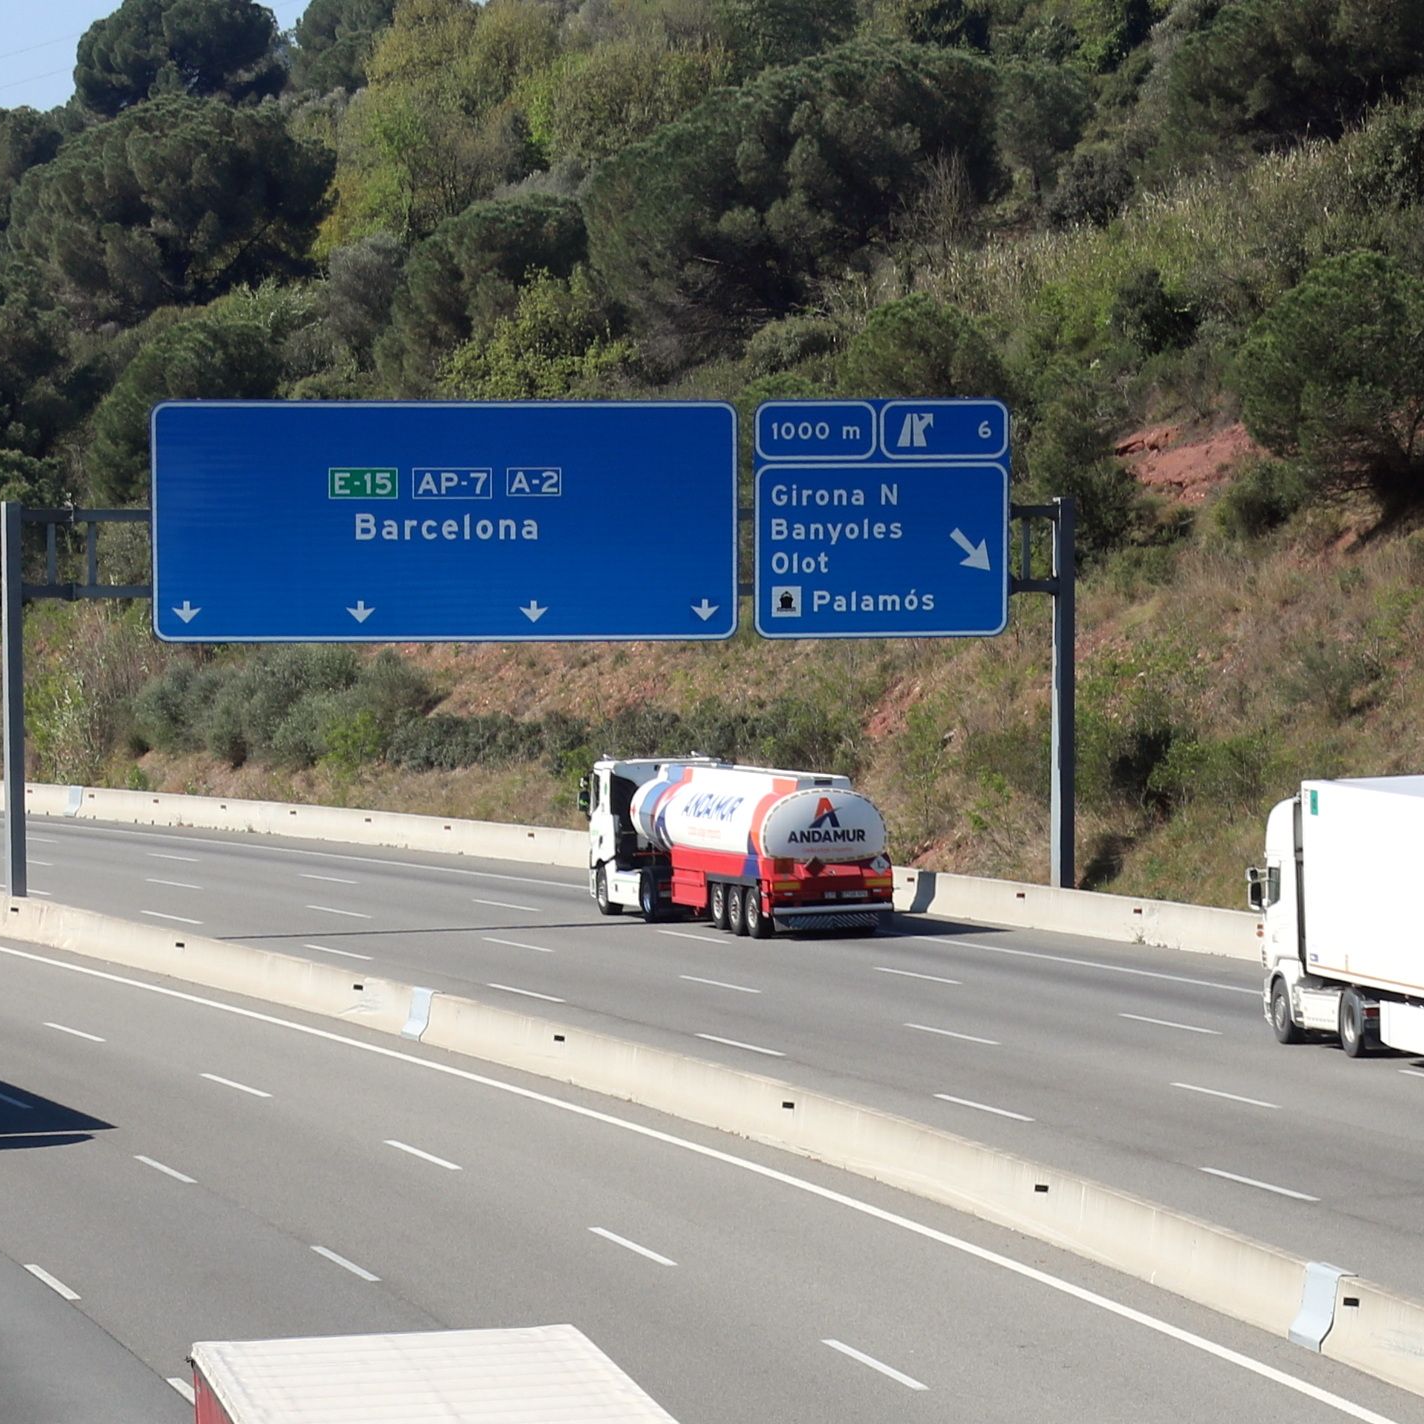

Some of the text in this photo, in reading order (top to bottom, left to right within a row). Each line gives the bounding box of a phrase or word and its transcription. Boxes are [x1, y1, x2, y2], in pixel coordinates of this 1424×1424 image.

[772, 422, 861, 440] 1000 m
[978, 420, 992, 439] 6
[334, 472, 393, 494] E-15
[417, 472, 487, 494] AP-7
[510, 471, 558, 493] A-2
[771, 483, 898, 506] Girona N
[355, 513, 538, 540] Barcelona
[771, 518, 902, 545] Banyoles
[771, 552, 829, 574] Olot
[812, 589, 935, 612] Palamós
[681, 792, 745, 823] ANDAMUR
[787, 829, 866, 844] ANDAMUR
